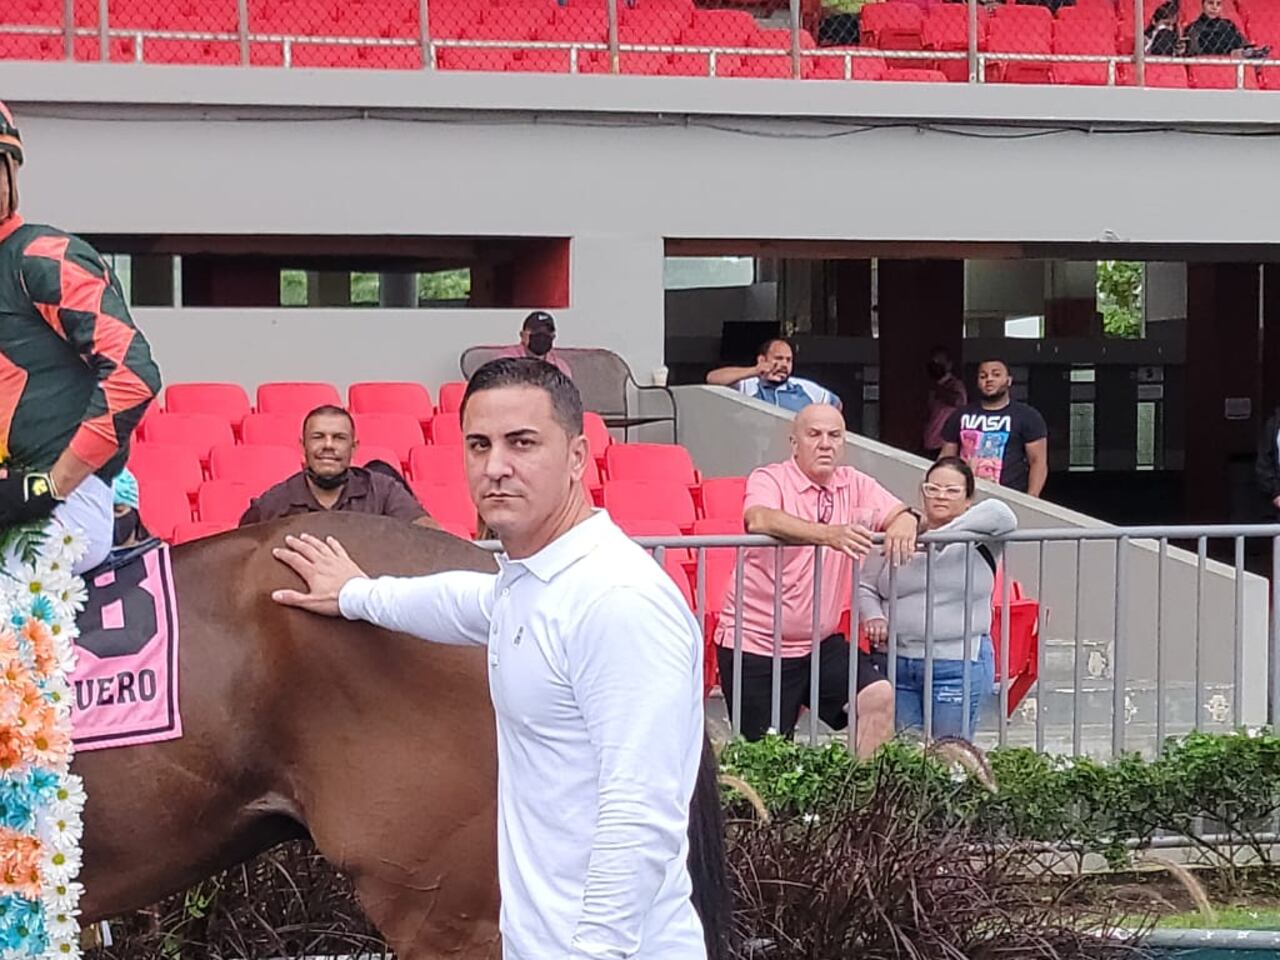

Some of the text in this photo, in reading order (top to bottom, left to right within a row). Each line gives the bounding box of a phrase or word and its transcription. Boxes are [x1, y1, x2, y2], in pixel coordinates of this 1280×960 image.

[960, 414, 1012, 432] NASA
[73, 556, 158, 660] 8
[66, 668, 157, 711] UERO
